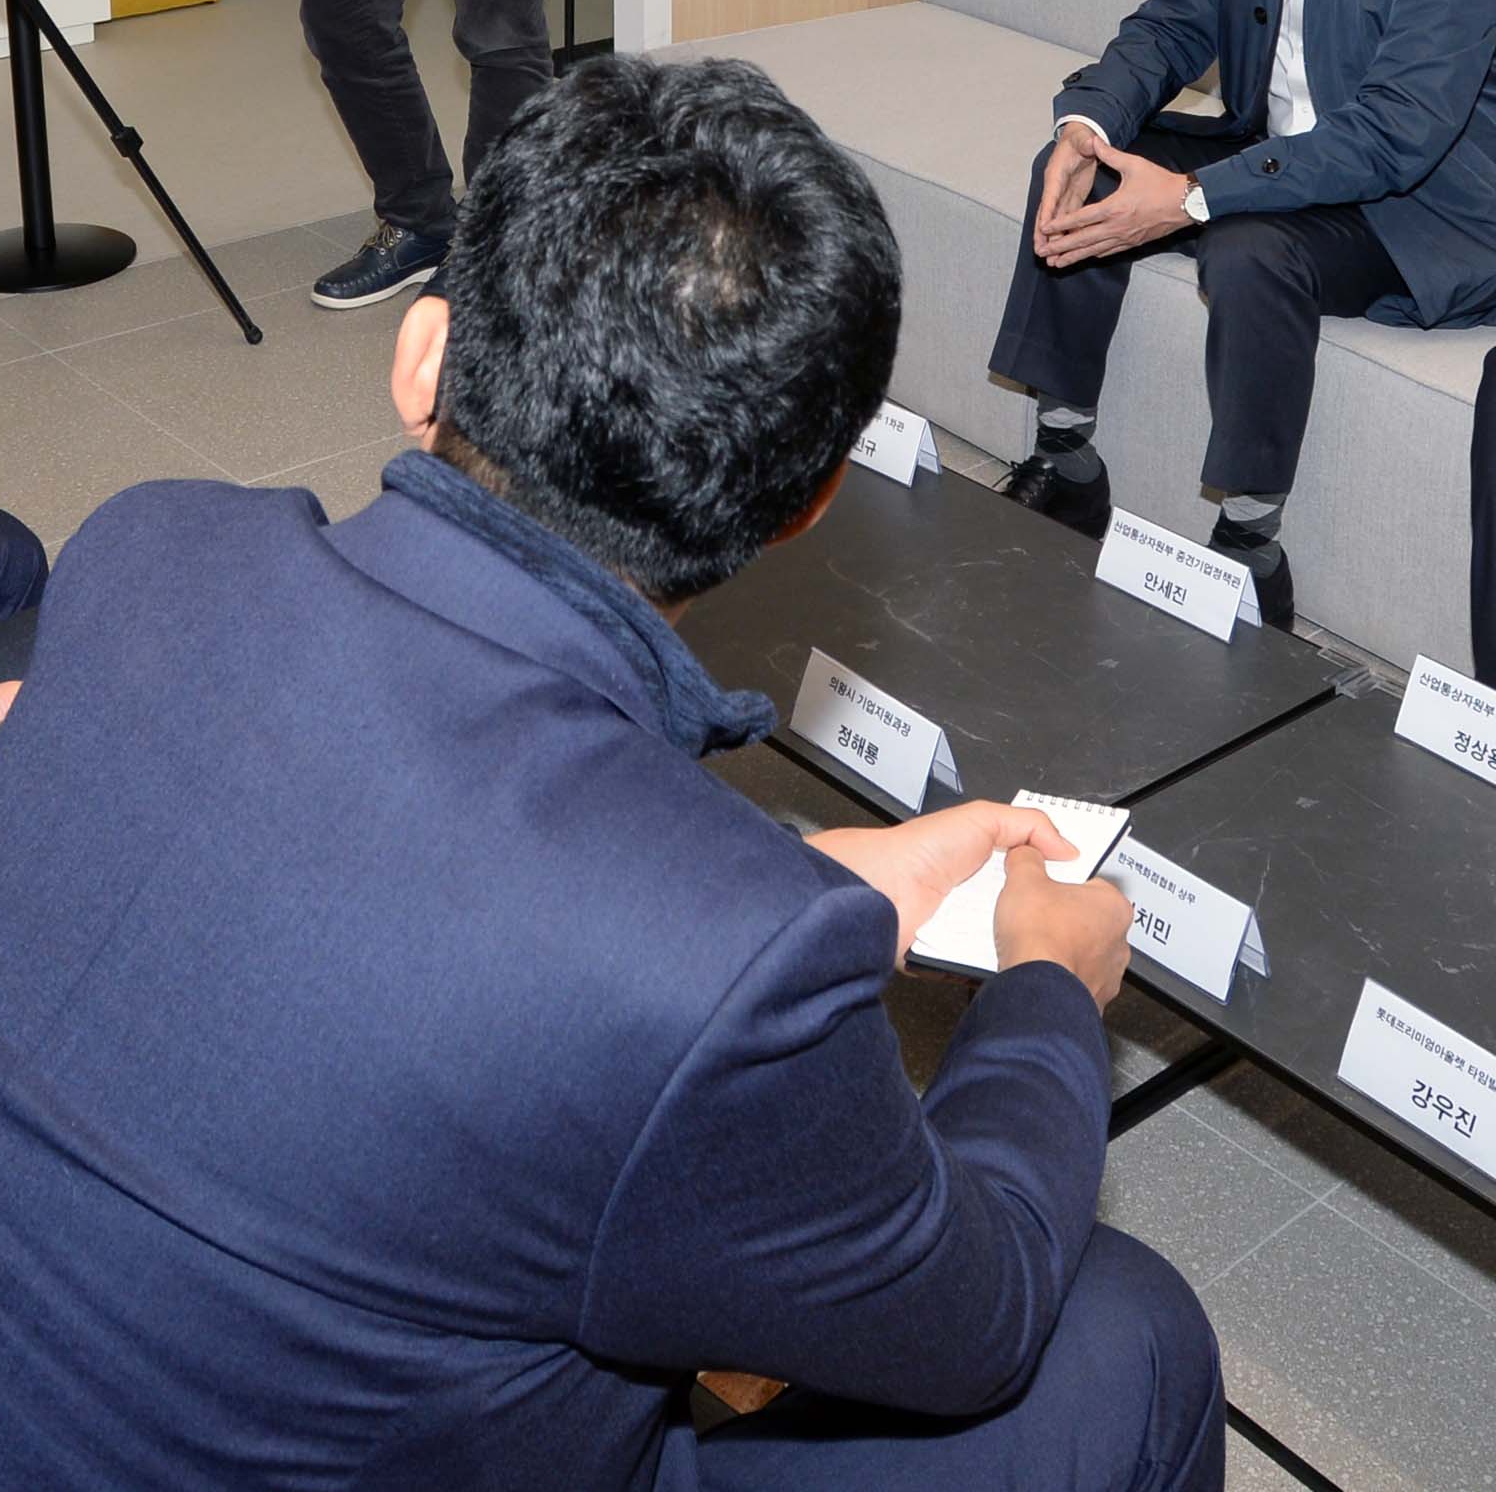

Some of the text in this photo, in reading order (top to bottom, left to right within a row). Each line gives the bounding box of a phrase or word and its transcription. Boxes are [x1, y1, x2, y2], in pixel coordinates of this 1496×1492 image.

[884, 416, 905, 434] 1차관
[1113, 520, 1242, 590] 산업통상자원부 중견기업정책관
[1144, 571, 1188, 606] 안세진
[828, 676, 912, 738] 의왕시 기업지원과장
[1418, 672, 1495, 717] 산업통상자원부
[837, 724, 880, 766] 정해룡
[1117, 851, 1197, 906] 한국백화점협회 상무
[1131, 901, 1172, 946] 치민
[1375, 1006, 1466, 1073] 롯데프리미엄아울렛
[1411, 1078, 1477, 1139] 강우진
